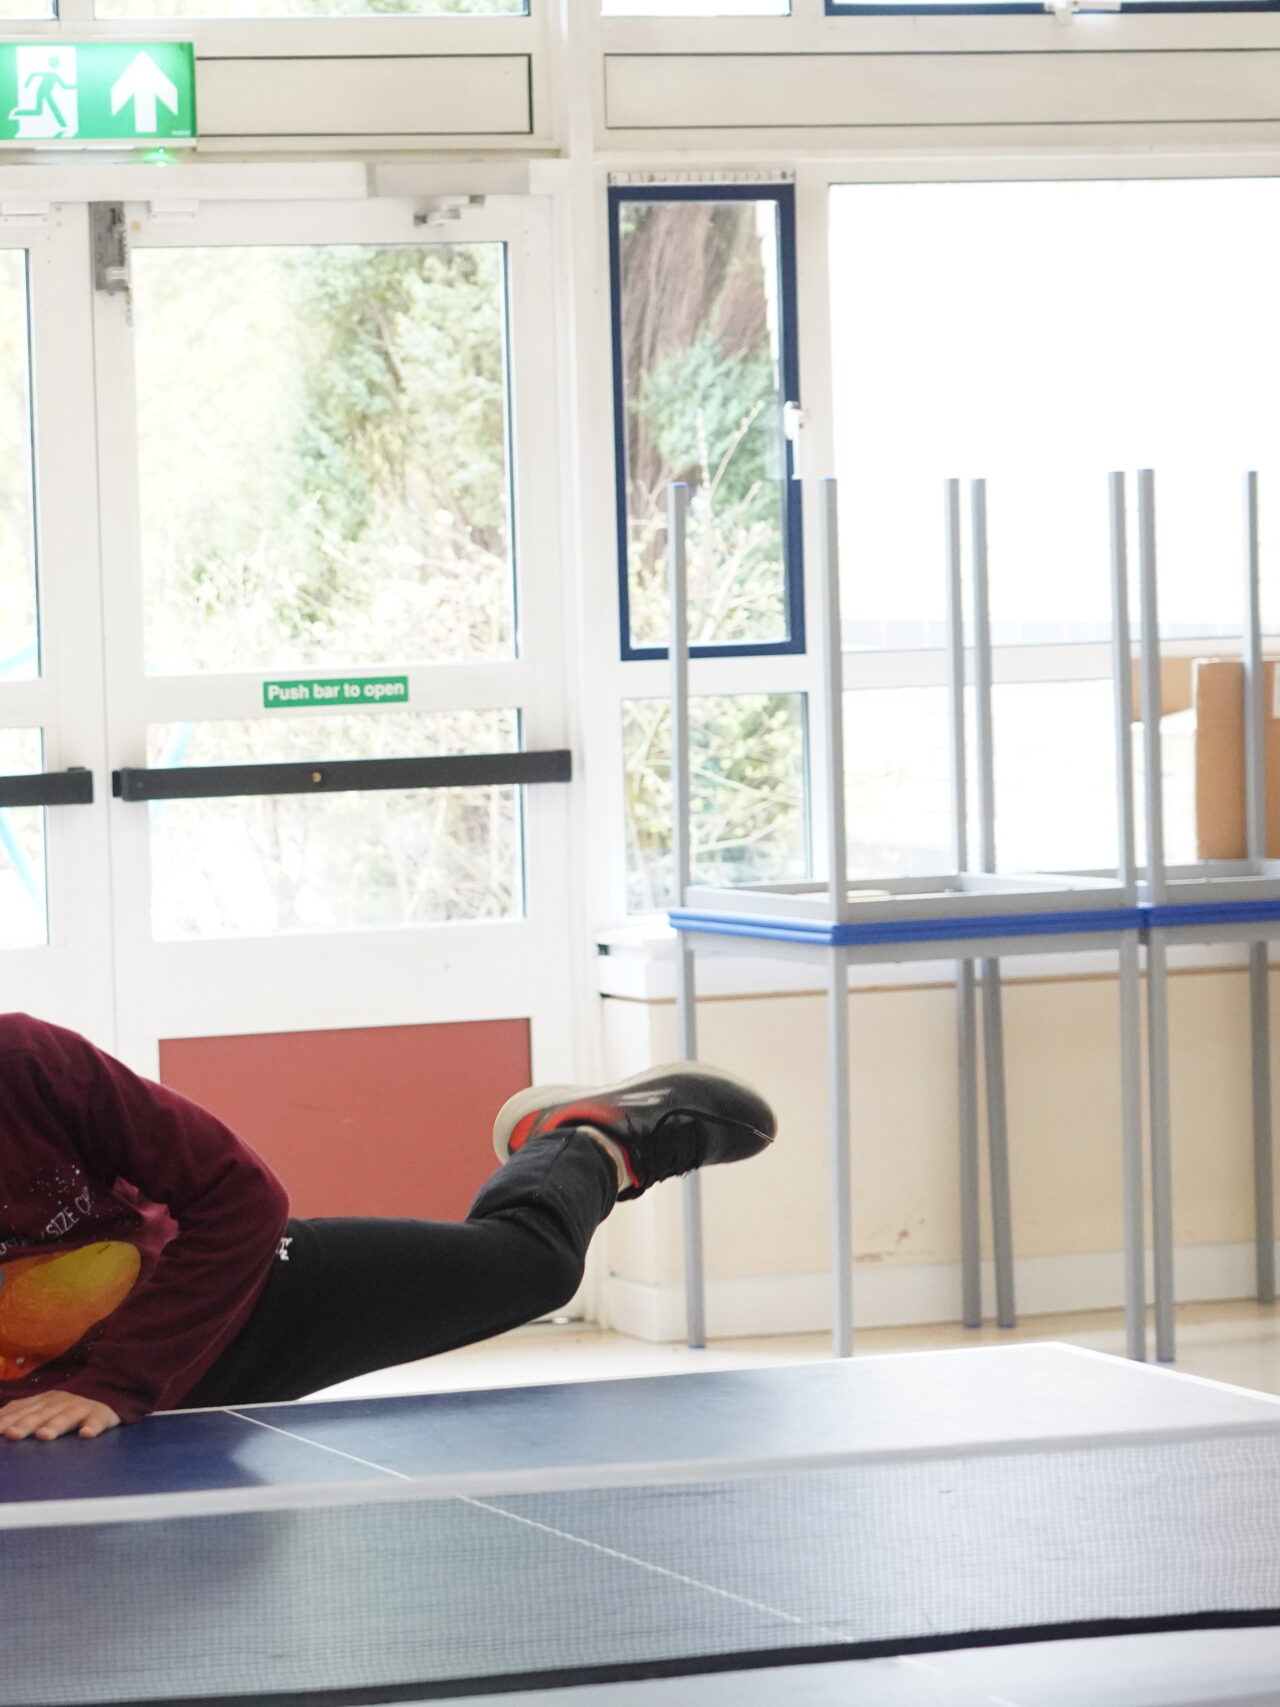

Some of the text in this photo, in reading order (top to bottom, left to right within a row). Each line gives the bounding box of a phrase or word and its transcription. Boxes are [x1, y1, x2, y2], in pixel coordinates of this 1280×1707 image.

[268, 682, 405, 701] Push bar to open
[45, 1205, 80, 1237] SIZE
